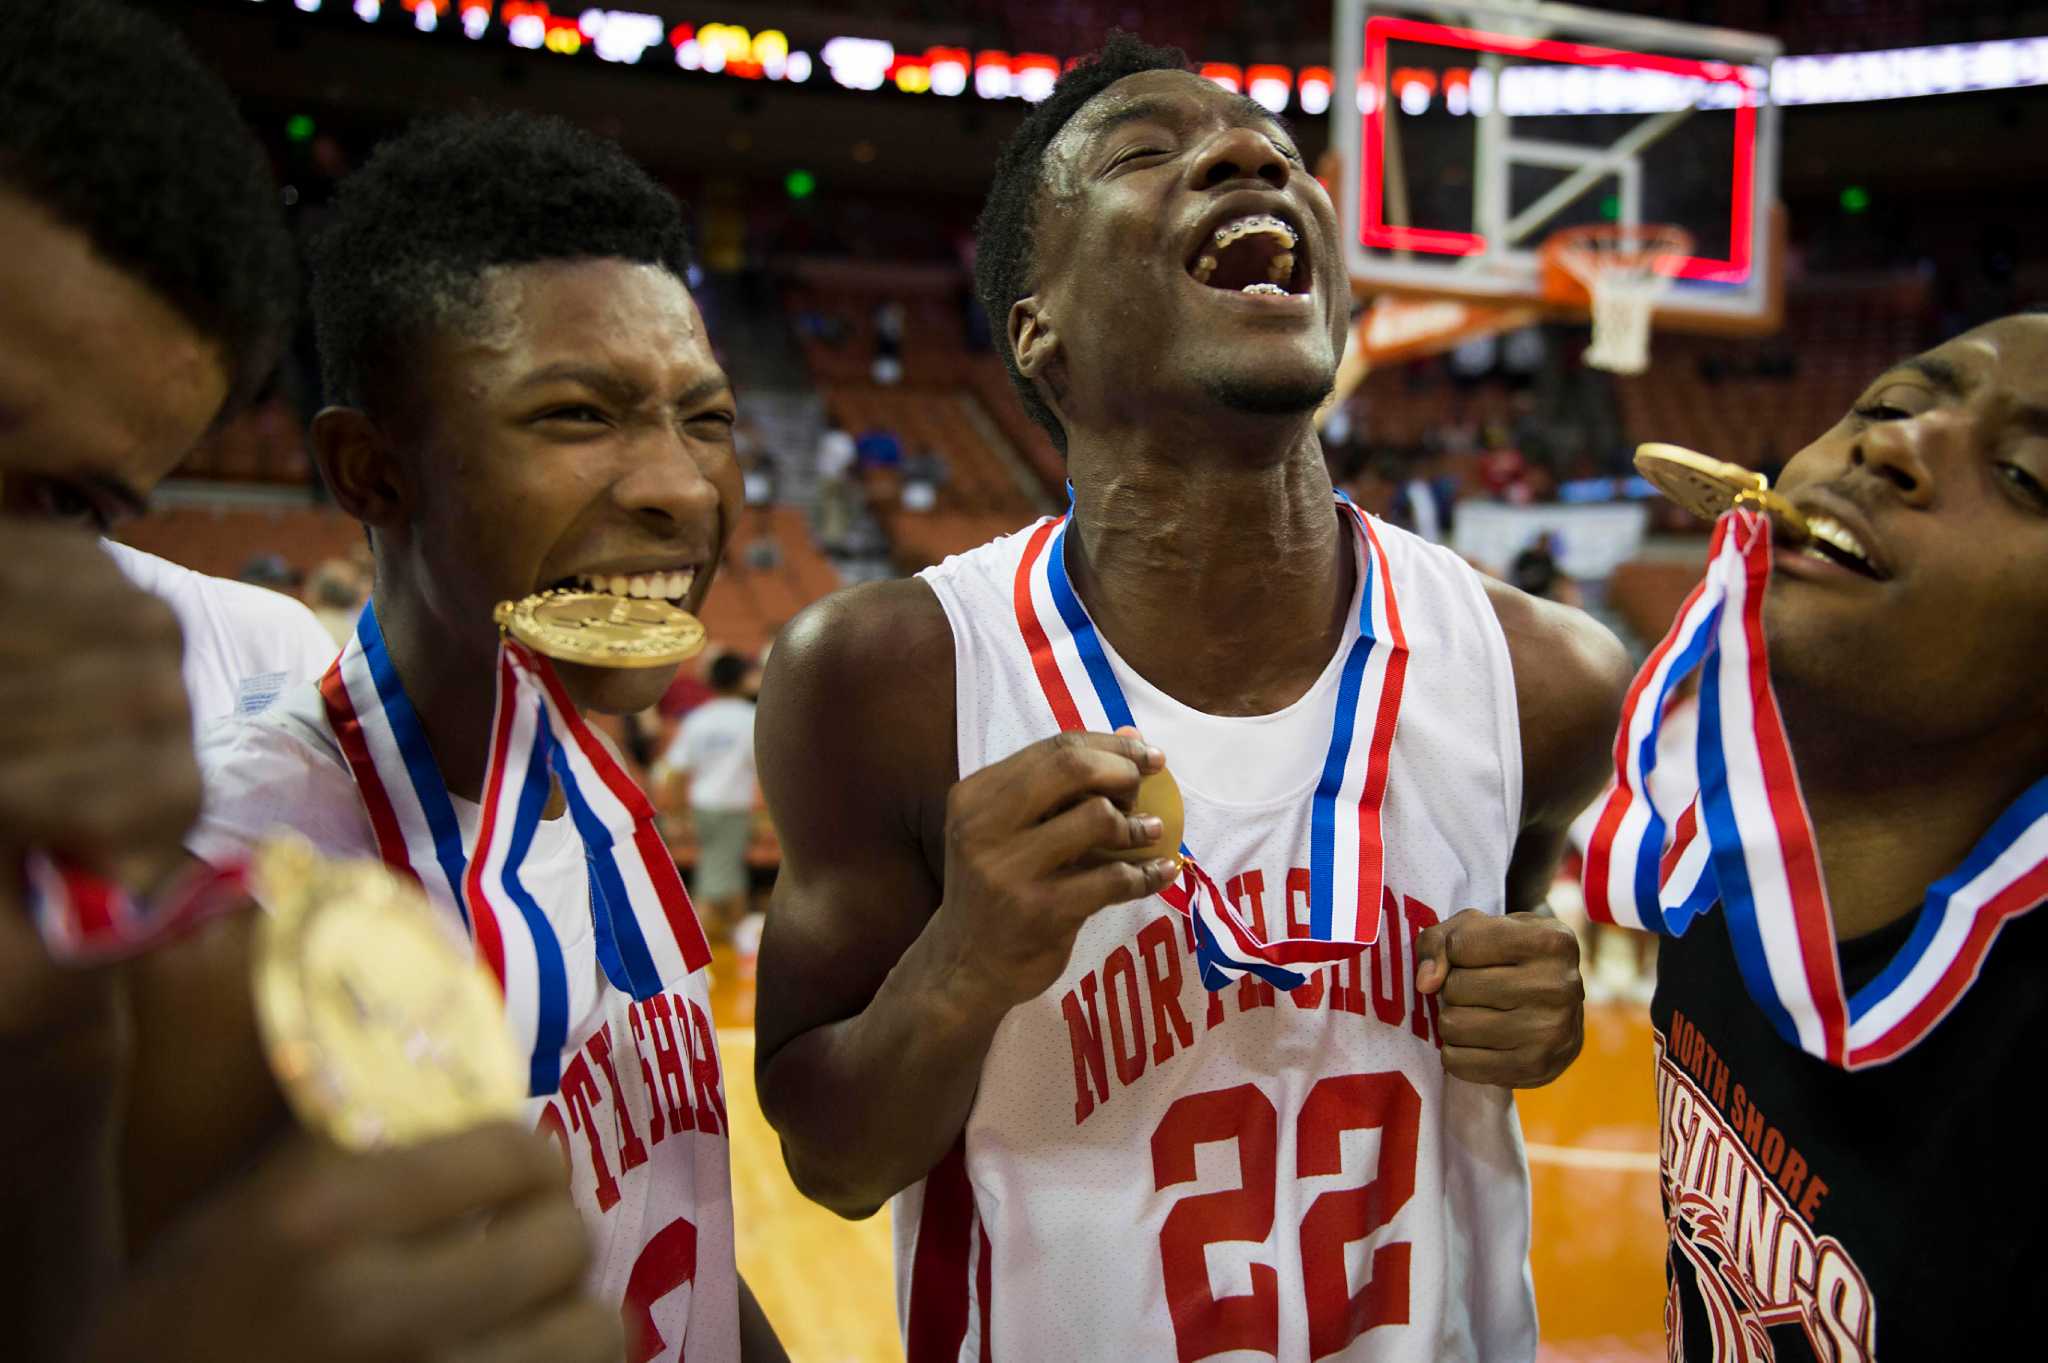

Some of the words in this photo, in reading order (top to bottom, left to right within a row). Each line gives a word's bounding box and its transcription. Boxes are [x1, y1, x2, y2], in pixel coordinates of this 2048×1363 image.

[1151, 1070, 1422, 1363] 22
[1654, 1026, 1877, 1363] USTANGS
[1669, 1009, 1730, 1110] NORTH
[1730, 1083, 1831, 1223] SHORE
